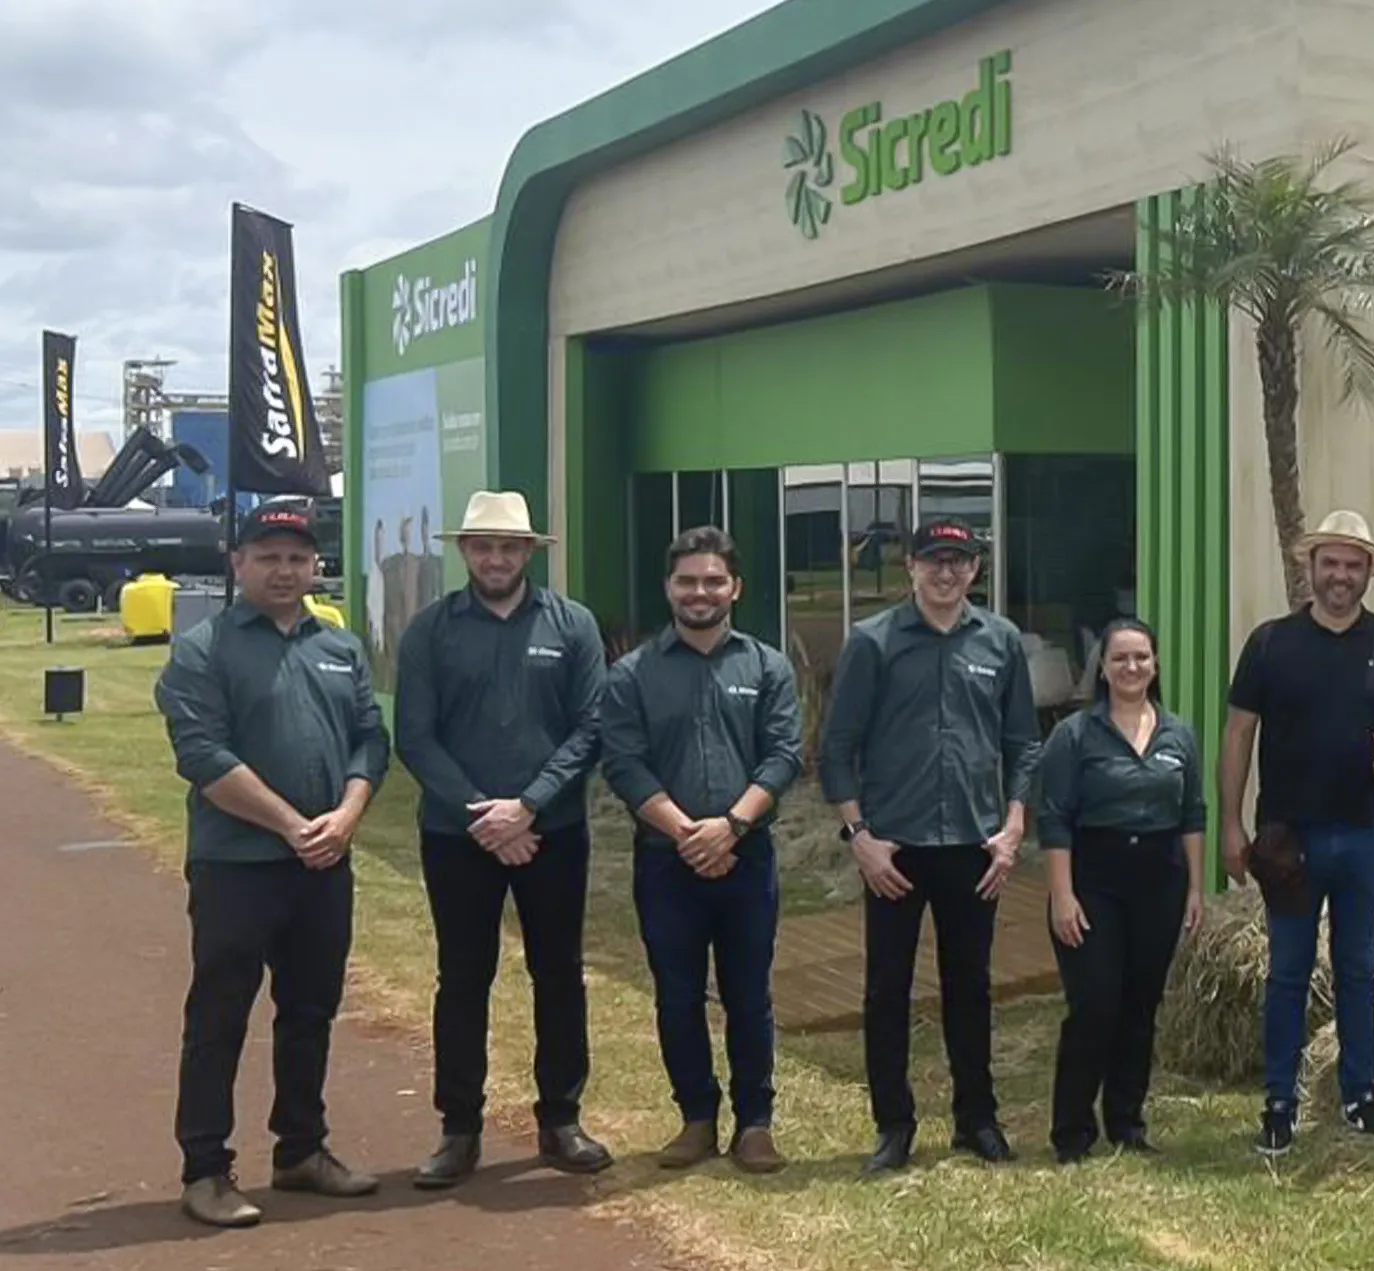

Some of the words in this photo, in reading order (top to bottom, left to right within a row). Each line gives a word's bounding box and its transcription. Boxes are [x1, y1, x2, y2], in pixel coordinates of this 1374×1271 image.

[839, 48, 1012, 206] Sicredi
[256, 249, 298, 460] SarraMax
[412, 257, 477, 338] Sicredi
